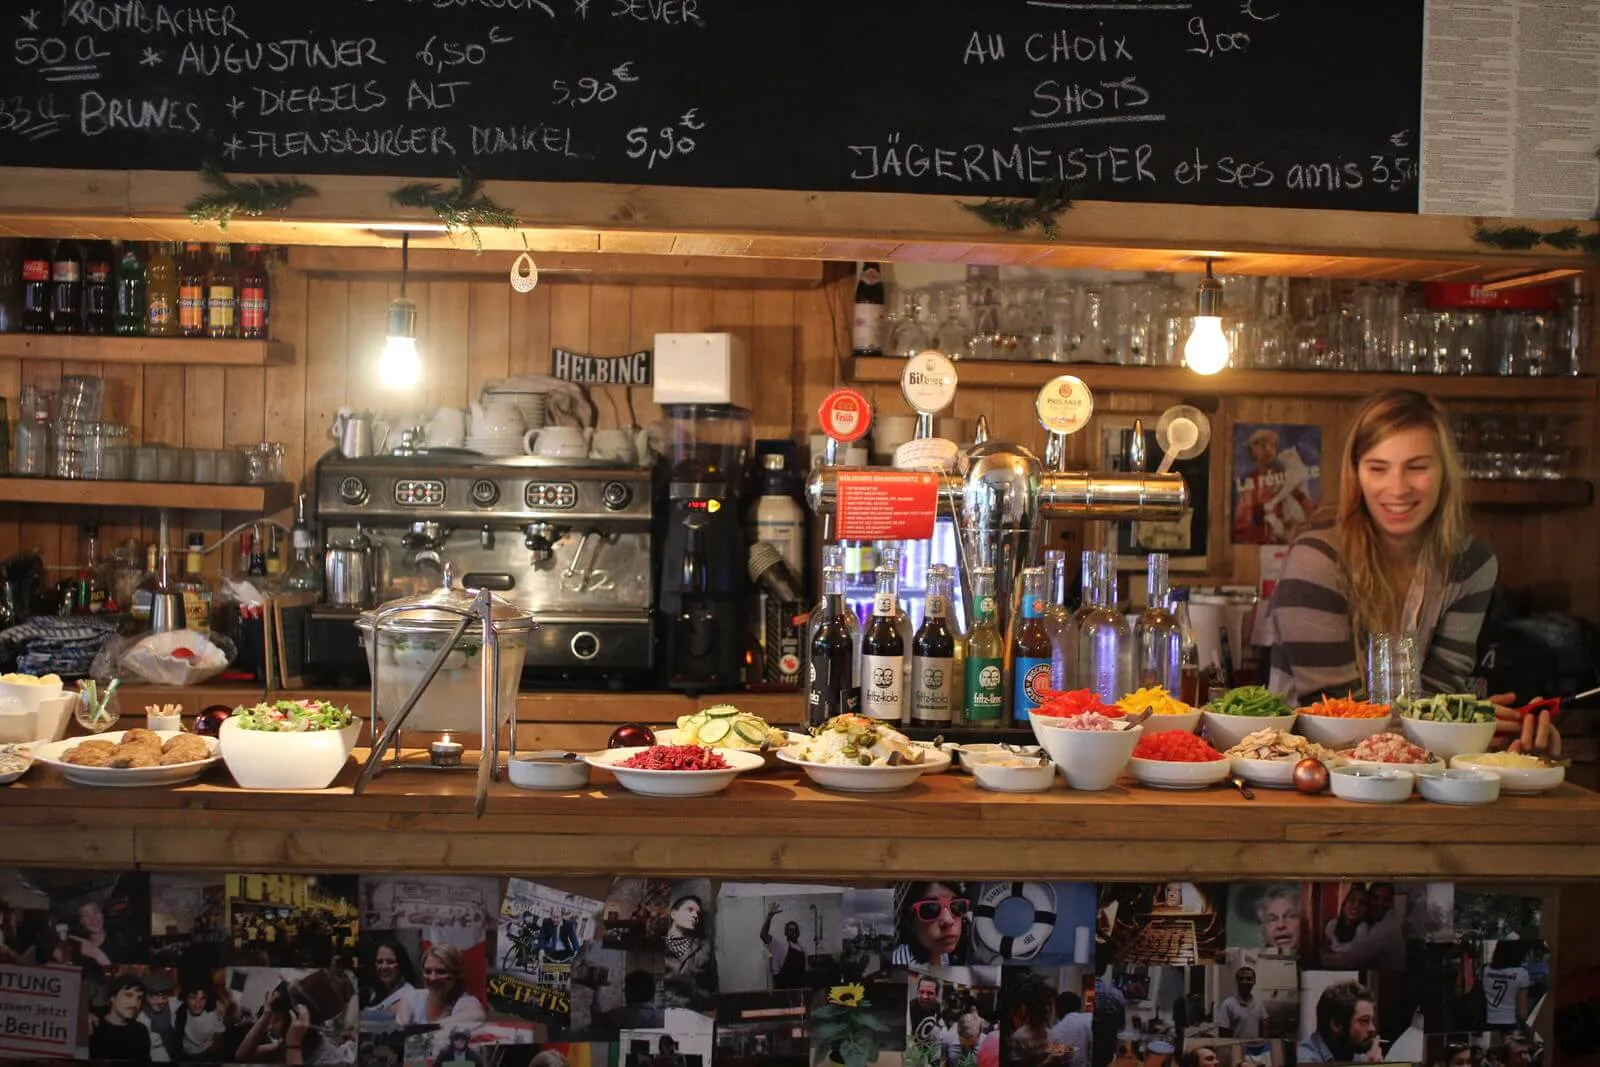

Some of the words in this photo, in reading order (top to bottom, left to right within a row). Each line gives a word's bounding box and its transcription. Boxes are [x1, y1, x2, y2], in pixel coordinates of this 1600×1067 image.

[963, 31, 1006, 65] AU
[406, 80, 472, 111] ALT
[1029, 76, 1150, 119] SHOTS
[847, 131, 1157, 184] JÄGERMEISTER
[1173, 146, 1209, 185] et
[1285, 156, 1364, 192] amis
[555, 348, 648, 385] HELBING
